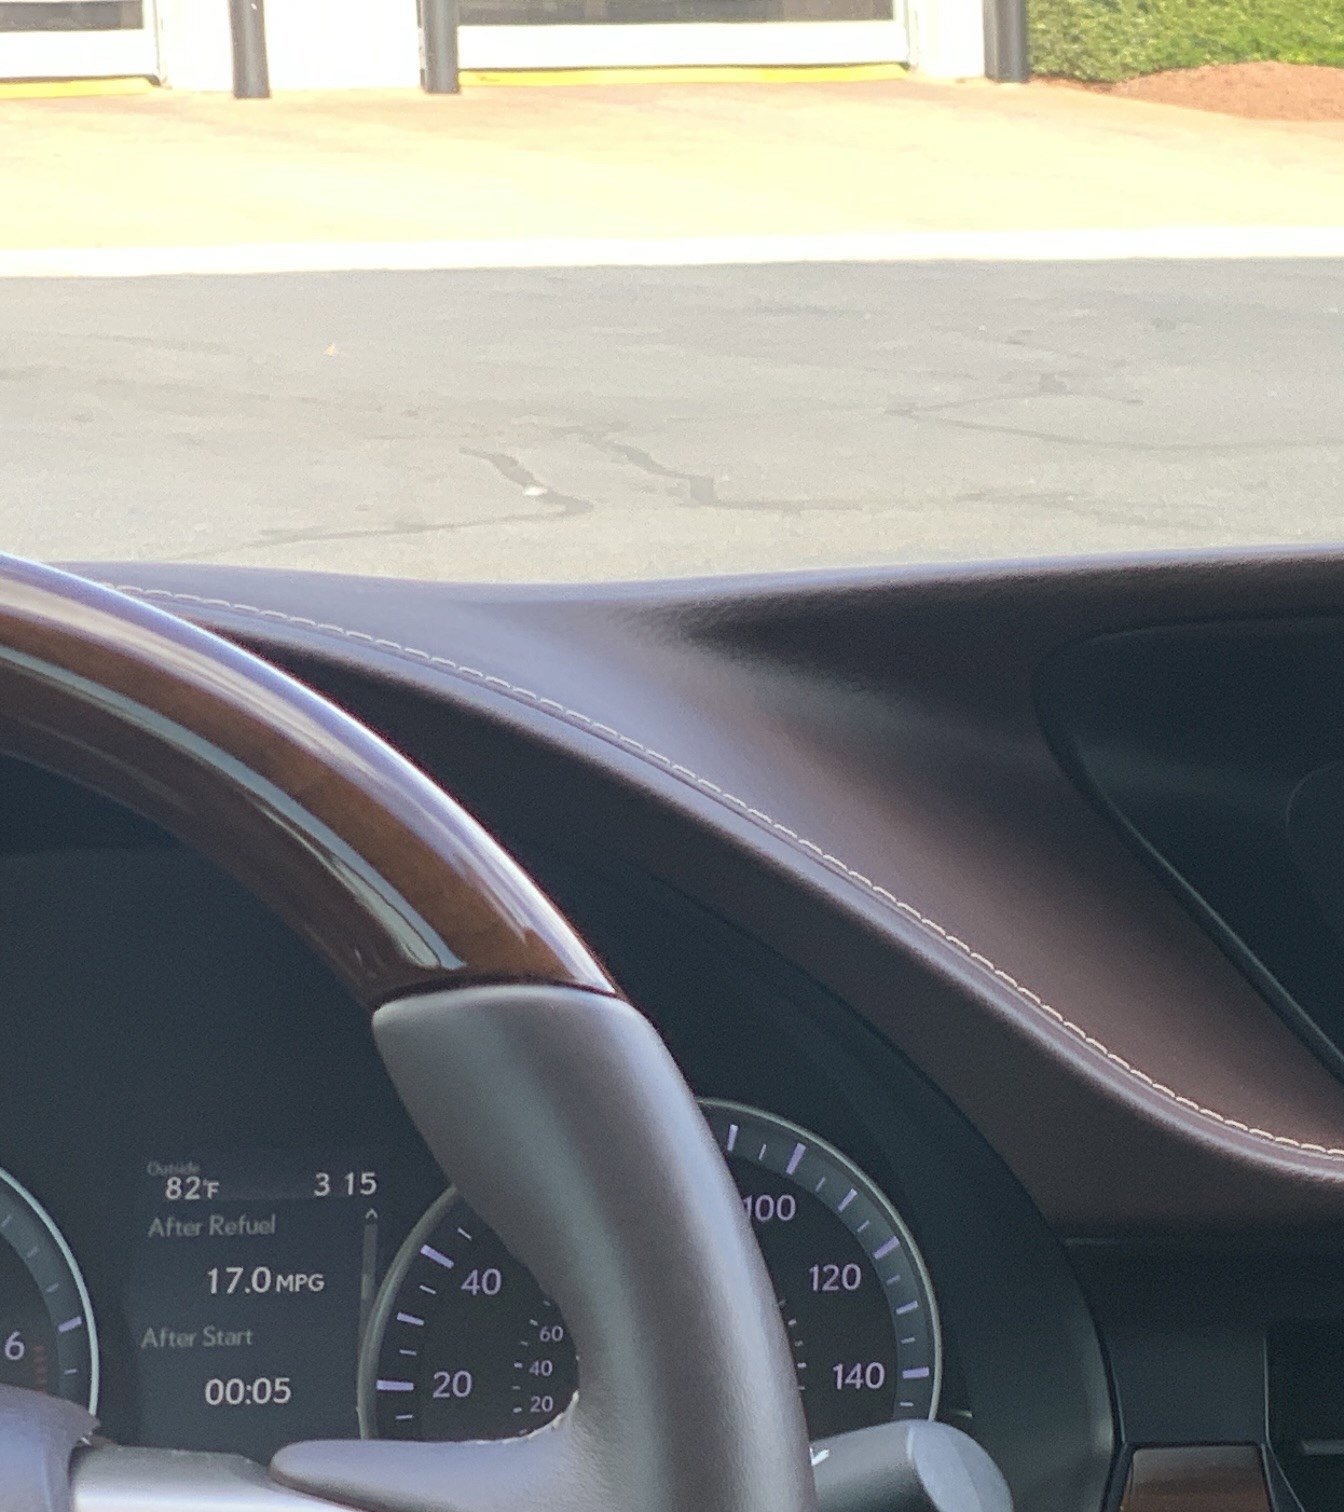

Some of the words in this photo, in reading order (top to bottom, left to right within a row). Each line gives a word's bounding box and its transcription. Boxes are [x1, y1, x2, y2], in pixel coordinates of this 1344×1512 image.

[148, 1216, 203, 1238] After
[208, 1213, 276, 1236] Refuel
[207, 1266, 273, 1295] 17.0
[276, 1274, 326, 1294] MPG
[461, 1268, 502, 1295] 40
[808, 1263, 862, 1292] 120
[5, 1331, 25, 1360] 6
[140, 1327, 196, 1350] After
[203, 1326, 254, 1348] Start
[539, 1325, 564, 1342] 60
[528, 1360, 553, 1377] 40
[832, 1362, 886, 1391] 140
[204, 1378, 292, 1405] 00:05
[432, 1371, 473, 1399] 20
[530, 1395, 554, 1413] 20
